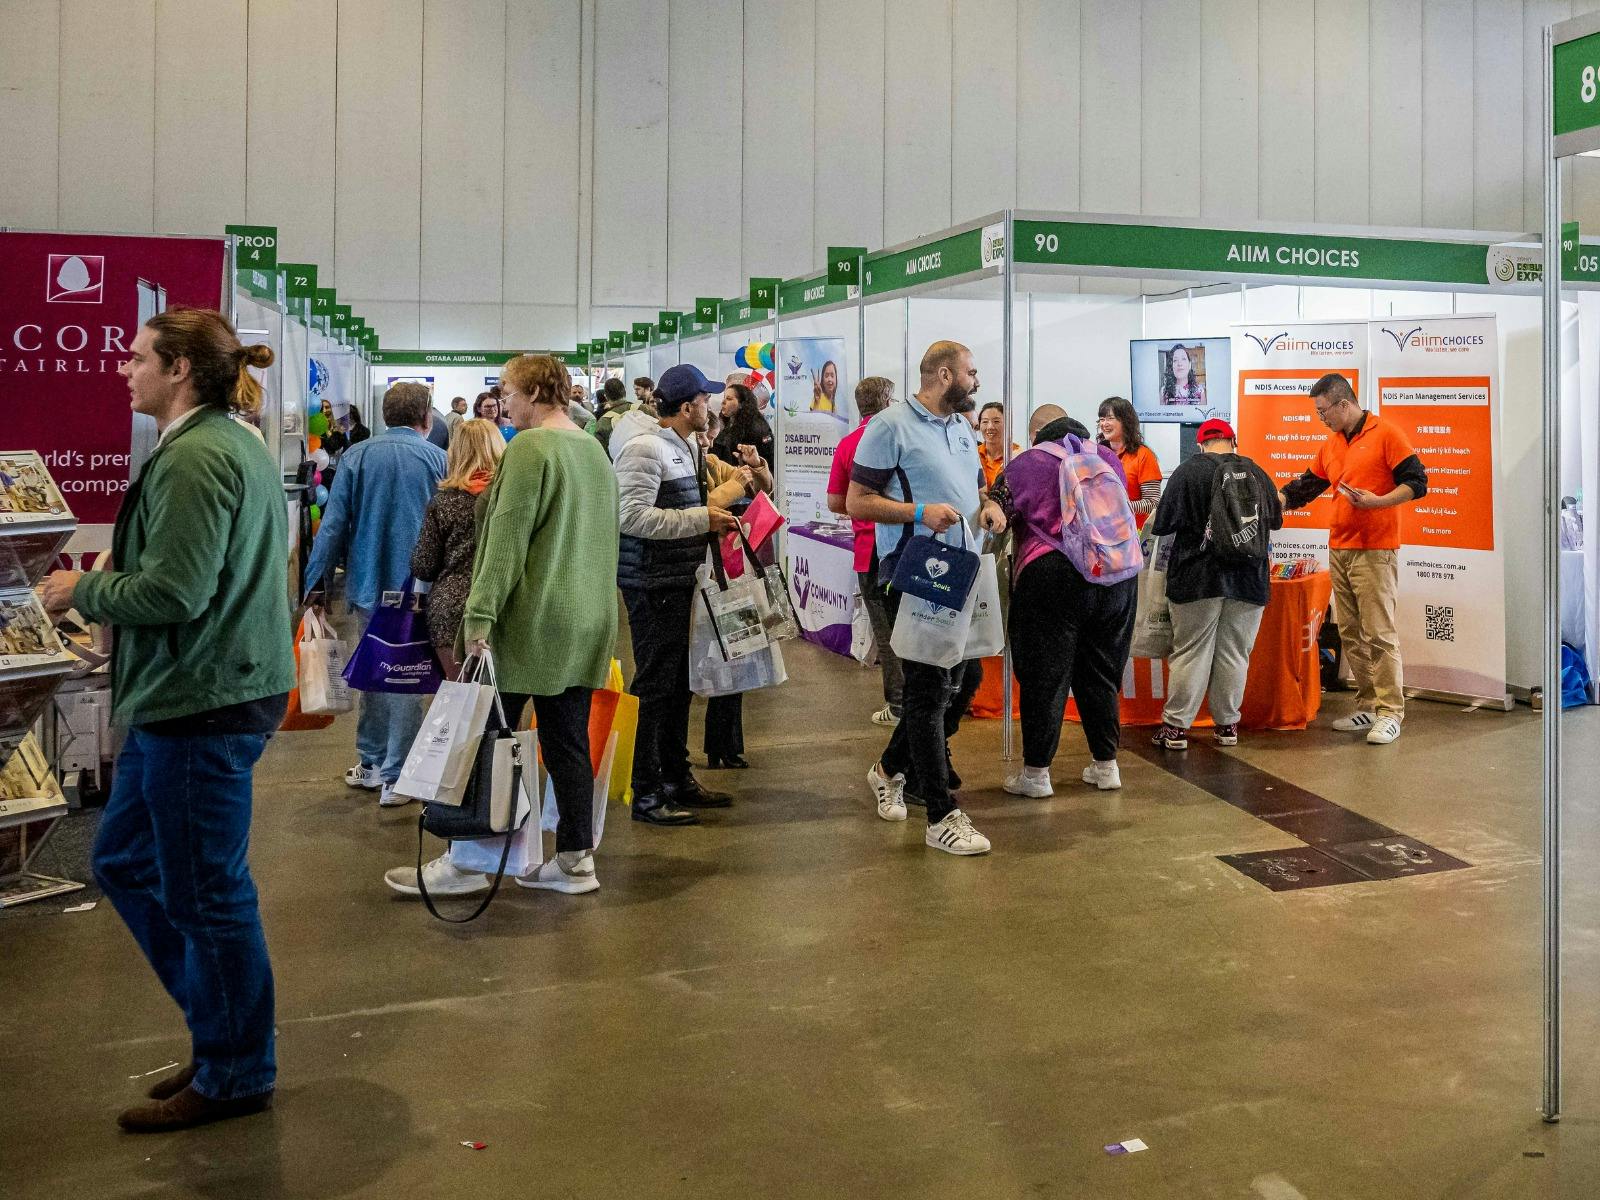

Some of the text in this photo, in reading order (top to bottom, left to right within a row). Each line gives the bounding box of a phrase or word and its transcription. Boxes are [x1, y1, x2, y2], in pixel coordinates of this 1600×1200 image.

[1581, 65, 1600, 103] 8
[236, 236, 275, 248] PROD
[1034, 234, 1059, 252] 90
[1563, 240, 1573, 251] 90
[251, 250, 260, 261] 4
[1226, 245, 1360, 268] AIIM CHOICES
[837, 262, 851, 272] 90
[917, 252, 941, 273] CHOICES
[1574, 255, 1598, 272] 05
[294, 277, 308, 286] 72
[757, 290, 768, 298] 91
[317, 299, 327, 307] 71
[335, 313, 345, 321] 70
[0, 324, 128, 353] COR
[1275, 337, 1354, 352] aiimCHOICES
[1411, 332, 1484, 347] aiimCHOICES
[1383, 392, 1486, 402] NDIS Plan Management Services
[784, 434, 821, 444] DISABILITY
[785, 446, 803, 455] CARE
[43, 449, 84, 467] rld's
[795, 555, 809, 578] AAA
[1416, 570, 1431, 578] 1800
[932, 581, 951, 592] Souls
[811, 582, 848, 612] COMMUNITY
[380, 660, 432, 673] myGuardian
